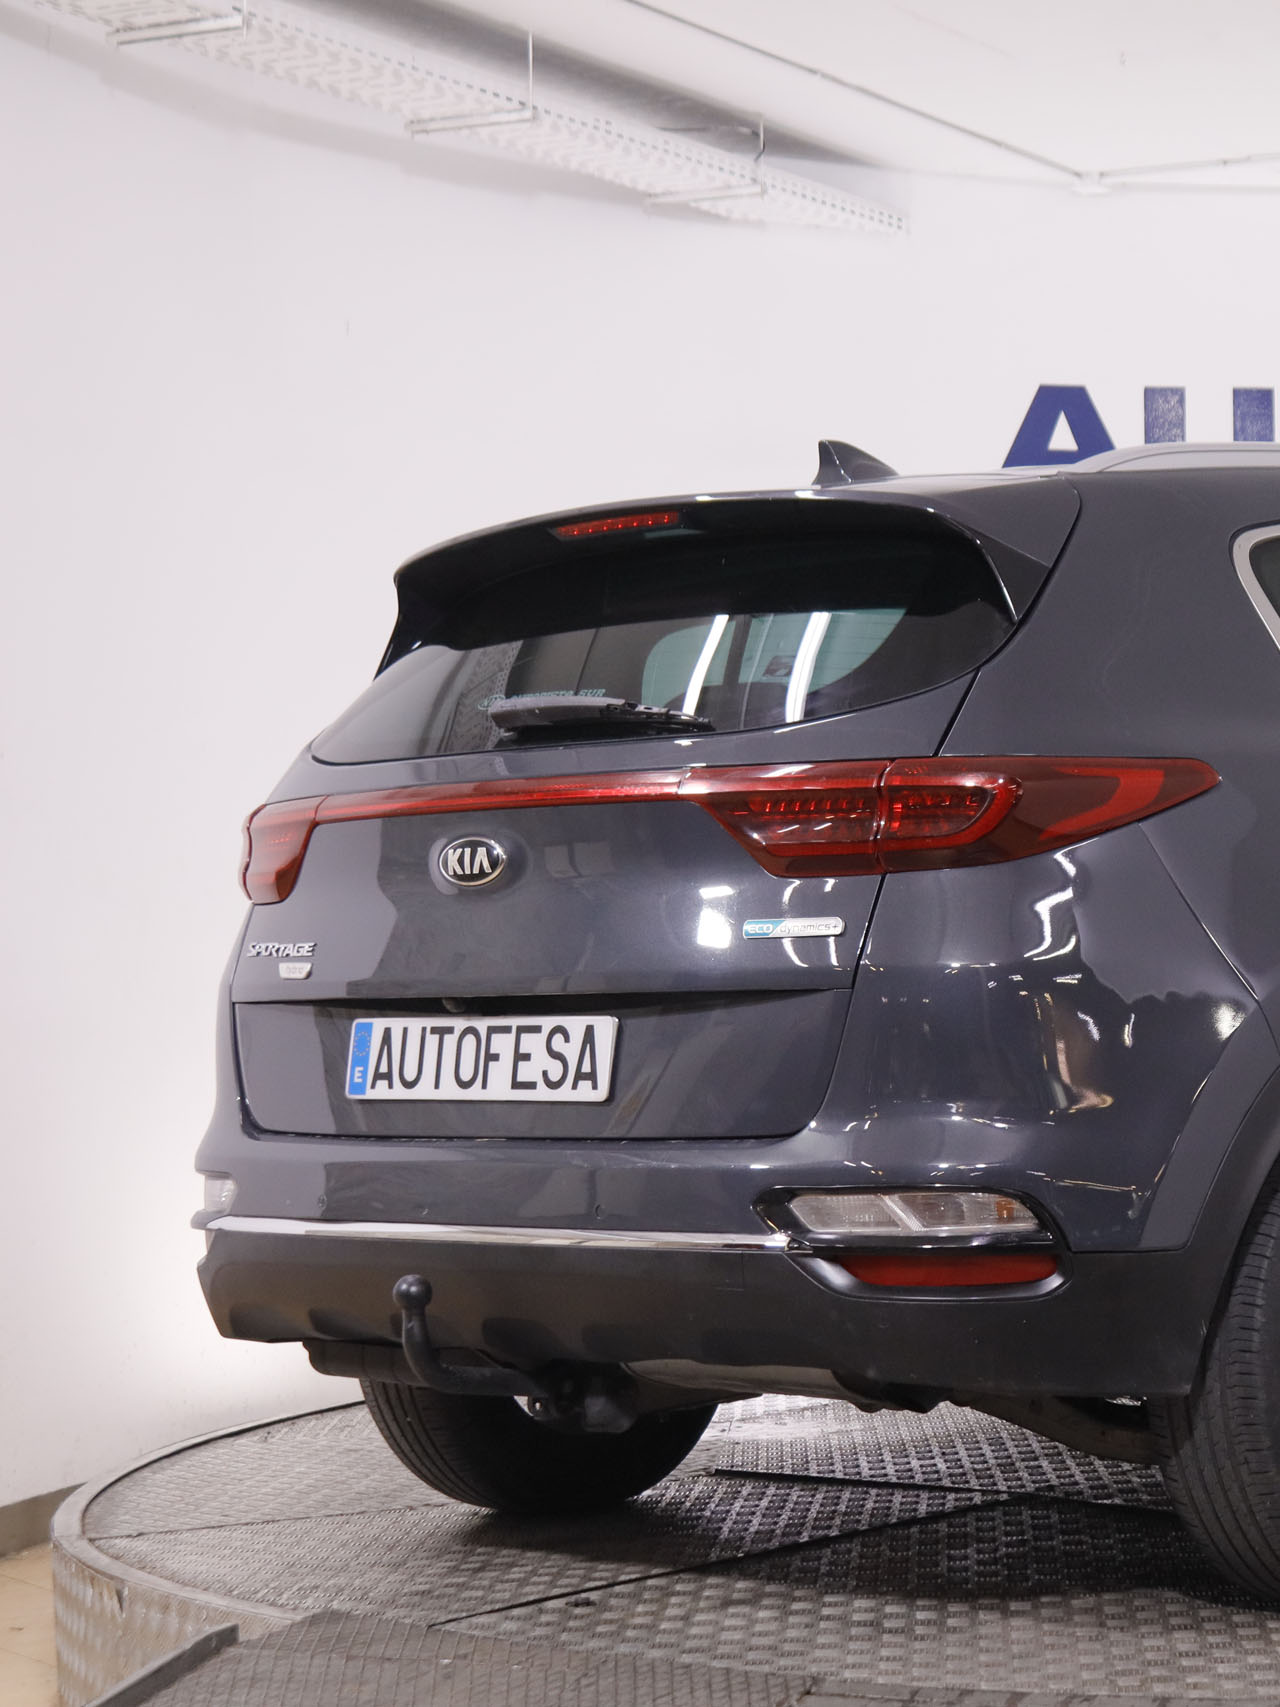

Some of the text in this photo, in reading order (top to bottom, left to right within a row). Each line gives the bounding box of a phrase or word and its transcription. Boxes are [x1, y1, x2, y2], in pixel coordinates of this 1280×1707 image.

[447, 846, 492, 876] KIA
[246, 942, 317, 958] SPORTAGE
[353, 1024, 599, 1091] E AUTOFESA
